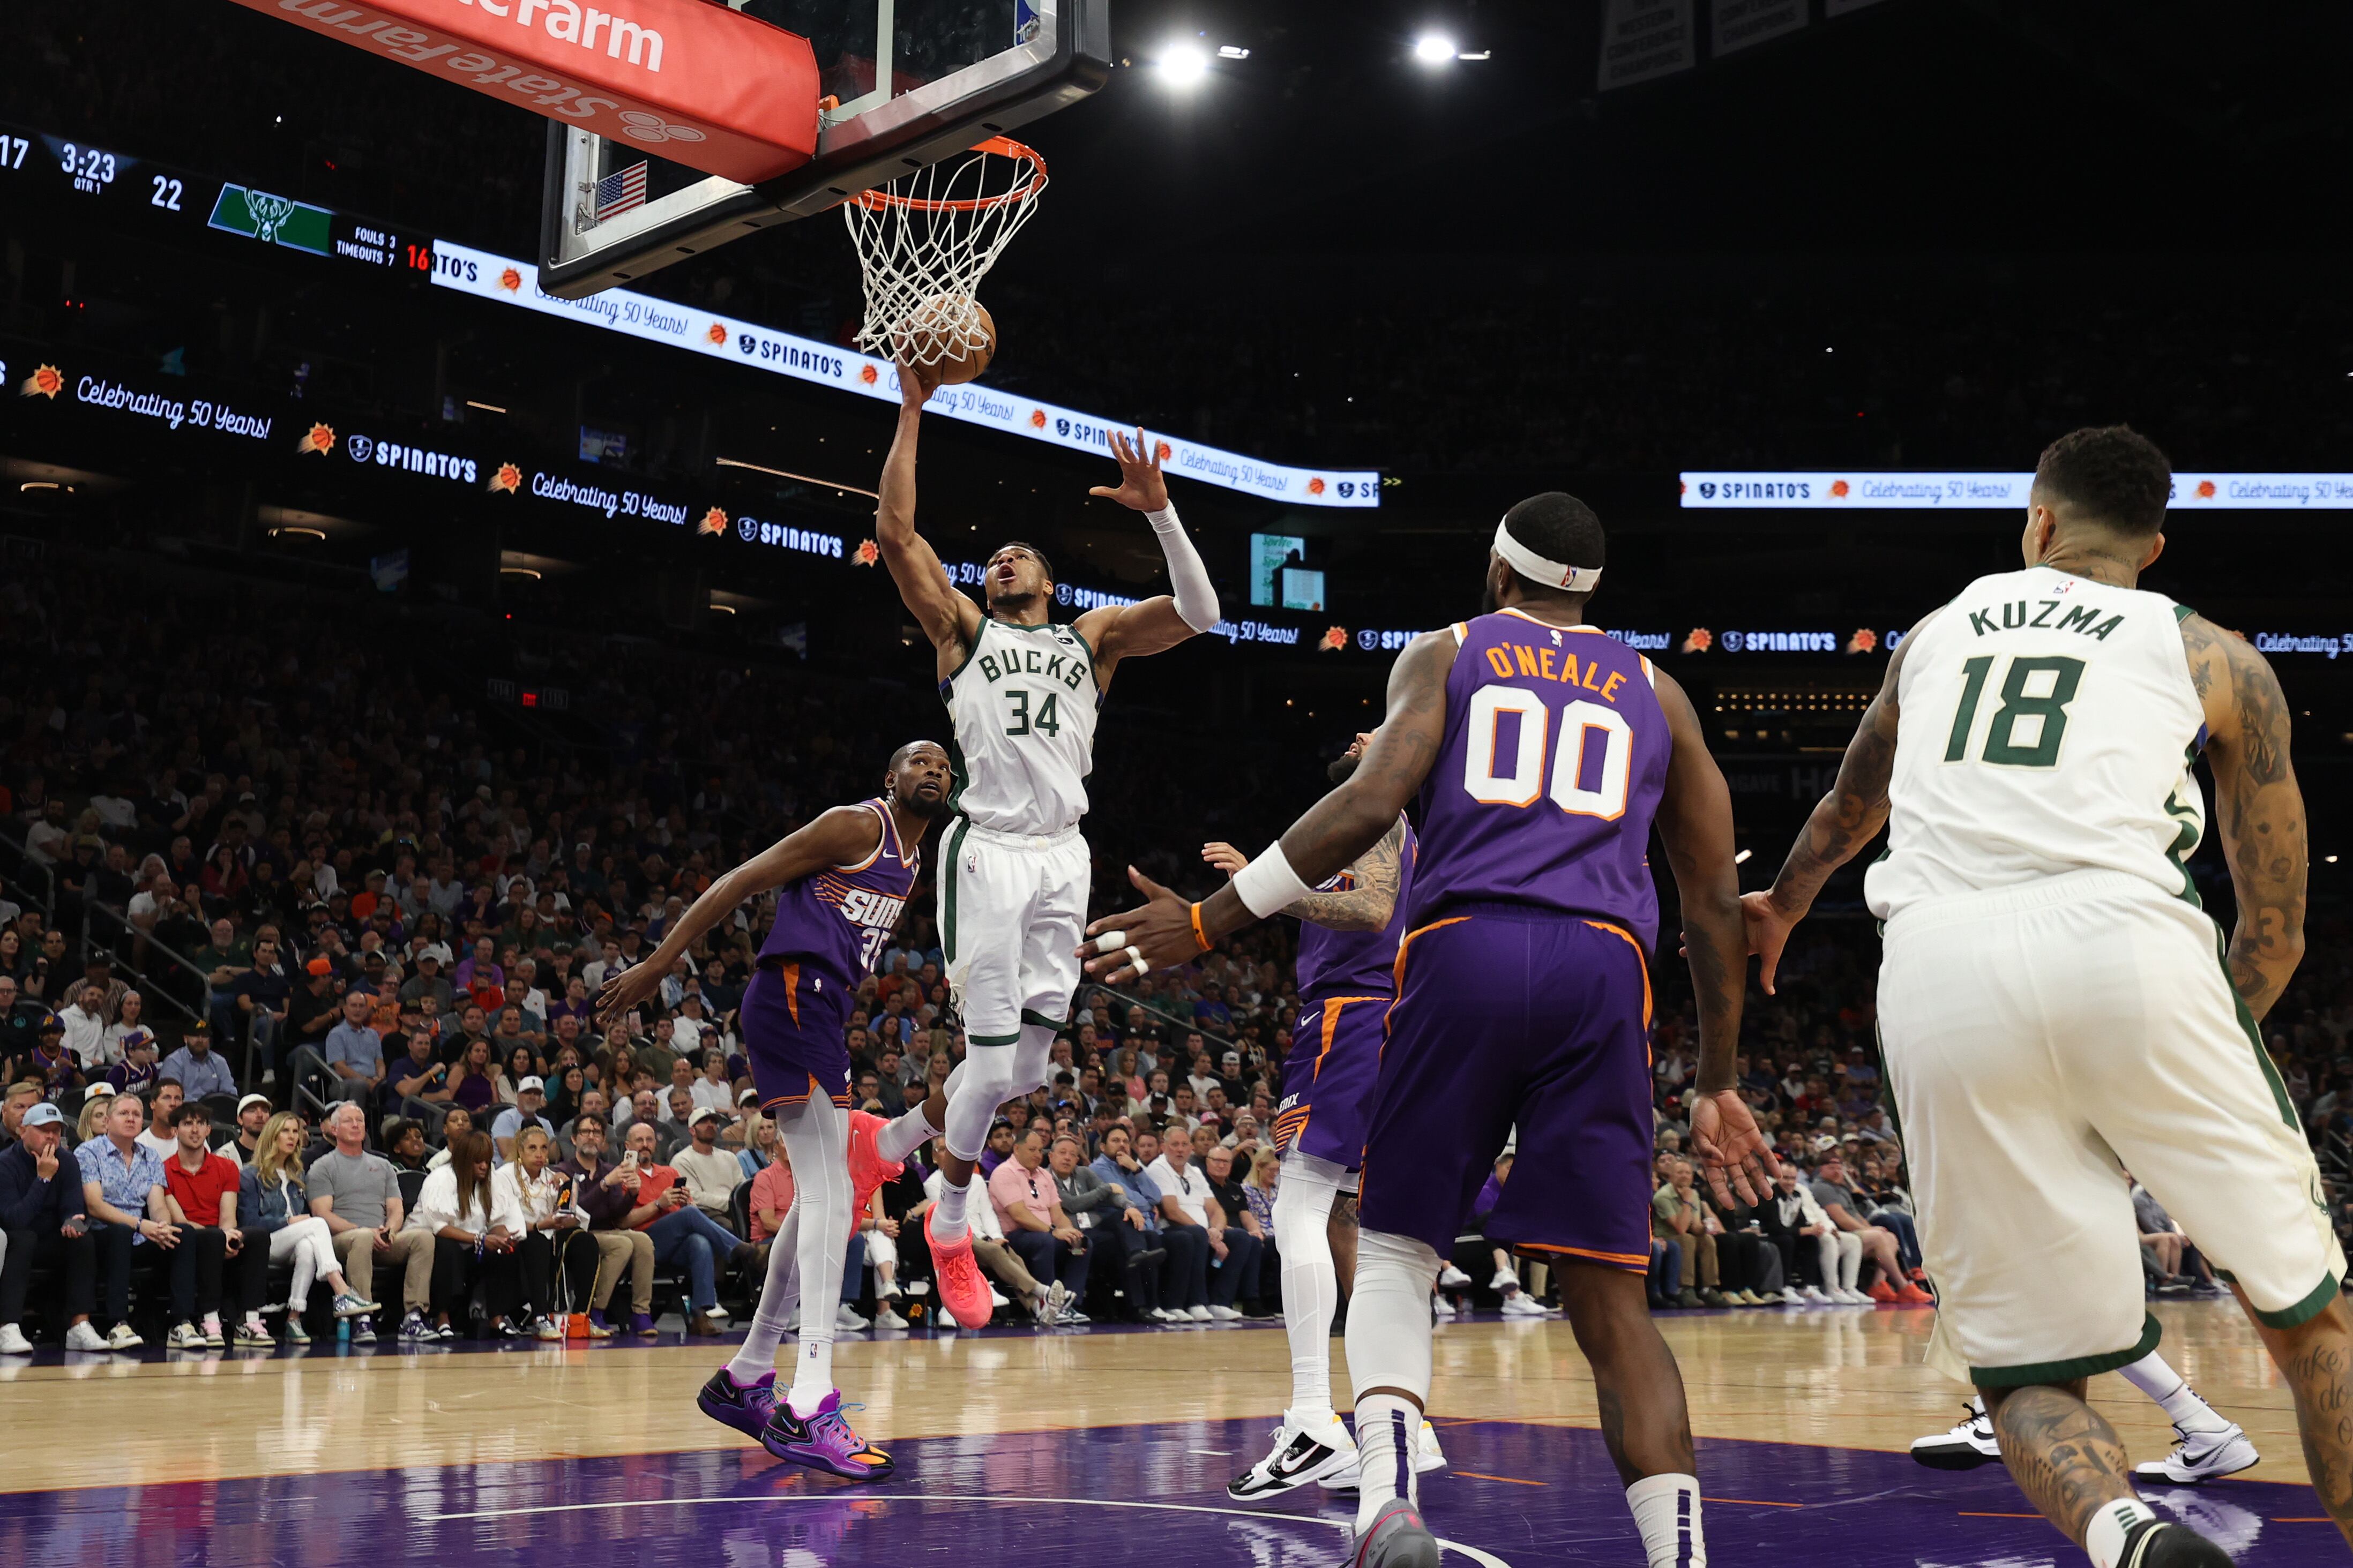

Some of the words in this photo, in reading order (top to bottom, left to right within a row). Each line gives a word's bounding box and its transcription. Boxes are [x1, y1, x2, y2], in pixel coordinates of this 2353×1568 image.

[0, 135, 29, 169] 17
[62, 143, 115, 183] 3:23
[74, 177, 93, 193] QTR
[96, 182, 101, 195] 1
[152, 175, 182, 211] 22
[337, 239, 384, 265] TIMEOUTS
[388, 253, 395, 267] 7
[355, 226, 385, 246] FOULS
[390, 235, 396, 249] 3
[407, 244, 429, 271] 16
[623, 302, 640, 322] 50
[644, 306, 688, 335] Years!
[761, 340, 842, 378] SPINATO'S
[77, 376, 185, 430] Celebrating
[188, 400, 212, 426] 50
[215, 404, 271, 439] Years!
[961, 391, 975, 411] 50
[978, 395, 1014, 421] Years!
[376, 441, 476, 483] SPINATO'S
[1181, 448, 1239, 485] Celebrating
[1241, 464, 1253, 483] 50
[1255, 468, 1288, 491] Years!
[532, 472, 617, 519] Celebrating
[622, 492, 639, 515] 50
[642, 496, 687, 526] Years!
[1722, 483, 1811, 499] SPINATO'S
[1863, 481, 1942, 504] Celebrating
[1947, 481, 1963, 498] 50
[1967, 482, 2012, 499] Years!
[2229, 481, 2310, 505] Celebrating
[760, 523, 842, 558] SPINATO'S
[959, 562, 975, 584] 50
[1240, 620, 1256, 640] 50
[1258, 622, 1299, 643] Years!
[1969, 599, 2125, 642] KUZMA
[1745, 632, 1837, 651] SPINATO'S
[2257, 632, 2341, 659] Celebrating
[978, 649, 1087, 691] BUCKS
[1486, 640, 1627, 703] O'NEALE
[1005, 691, 1060, 738] 34
[1941, 652, 2092, 770] 18
[1463, 684, 1633, 821] 00
